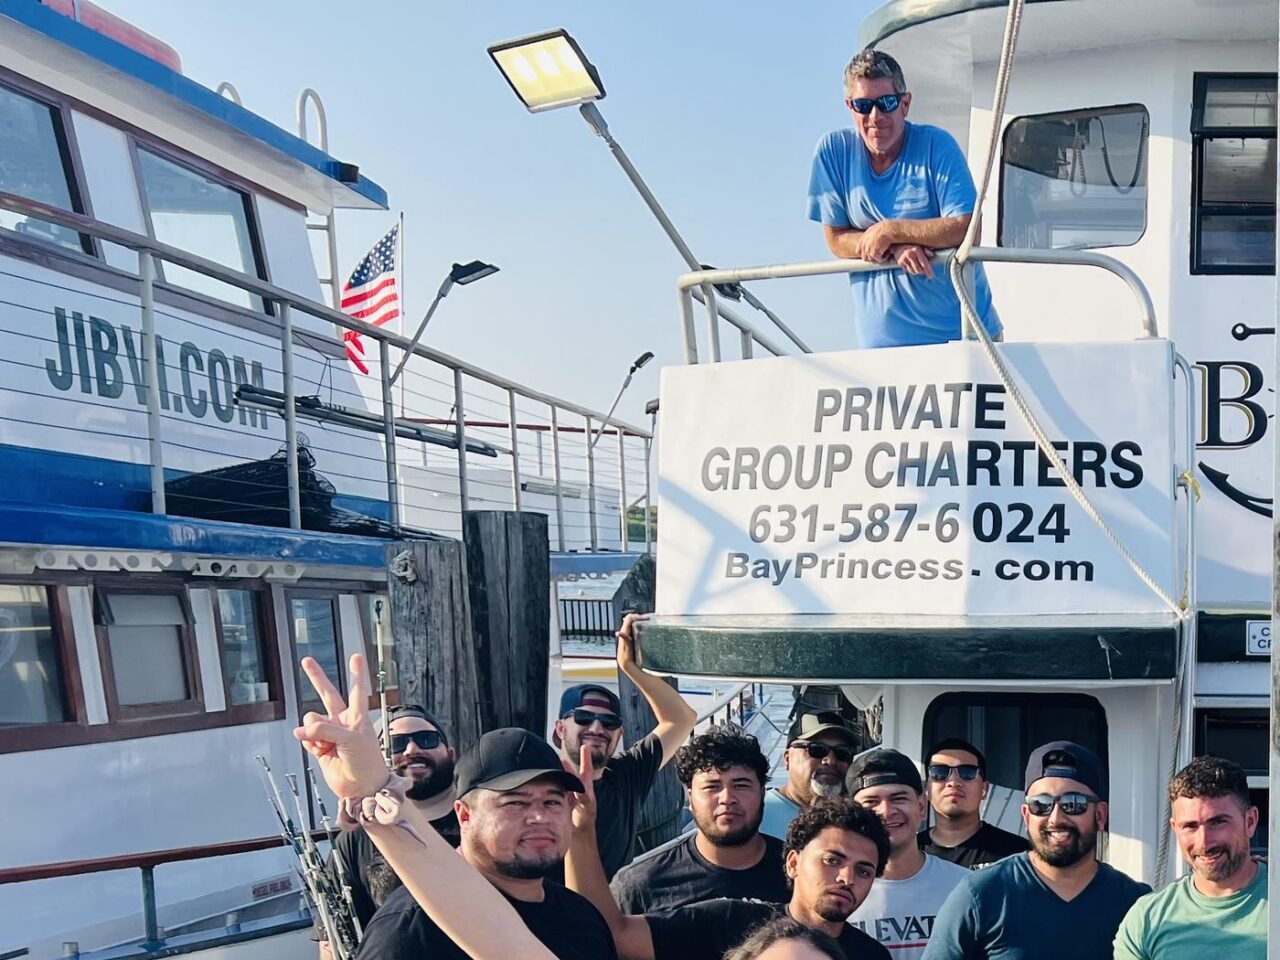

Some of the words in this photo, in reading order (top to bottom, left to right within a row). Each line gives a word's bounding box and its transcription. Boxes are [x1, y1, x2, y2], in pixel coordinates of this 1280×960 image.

[813, 382, 1007, 432] PRIVATE
[701, 444, 853, 491] GROUP
[864, 440, 1144, 490] CHARTERS
[748, 501, 1071, 544] 631-587-6024
